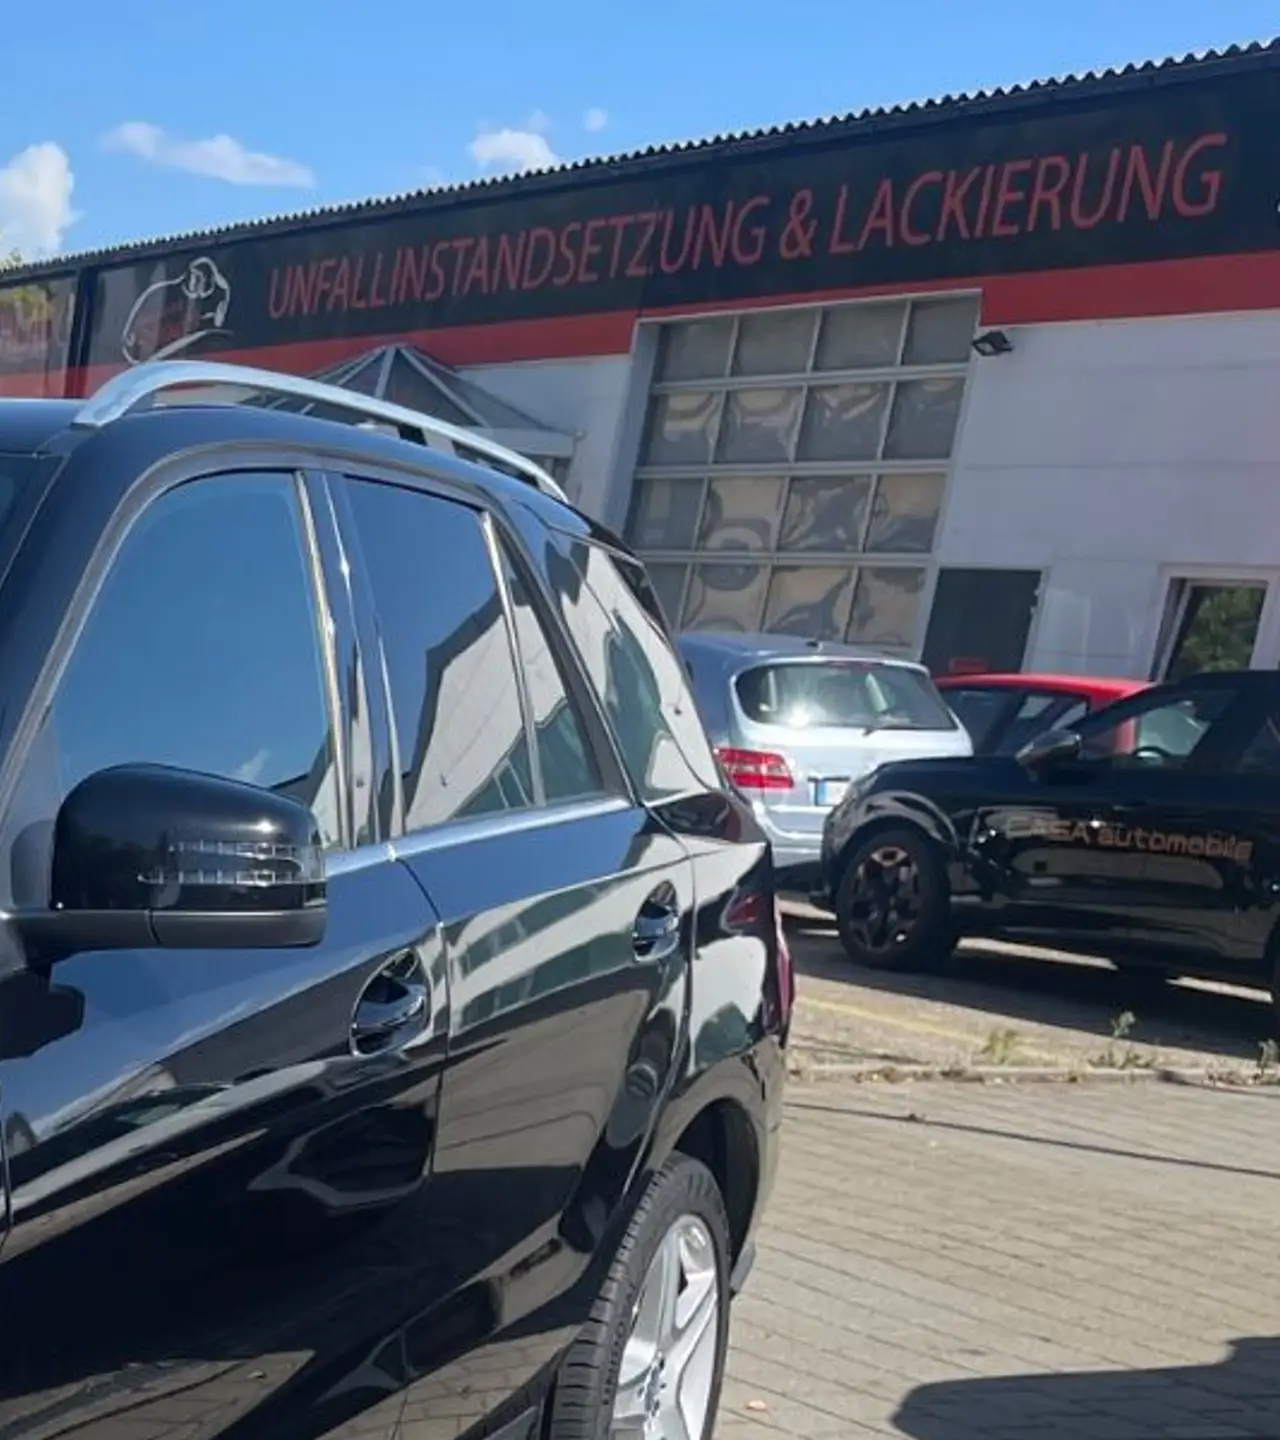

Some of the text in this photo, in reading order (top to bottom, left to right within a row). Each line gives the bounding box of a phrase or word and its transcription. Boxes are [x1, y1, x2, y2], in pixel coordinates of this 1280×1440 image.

[267, 133, 1228, 320] UNFALLINSTANDSETZUNG & LACKIERUNG
[1097, 824, 1254, 862] automobile
